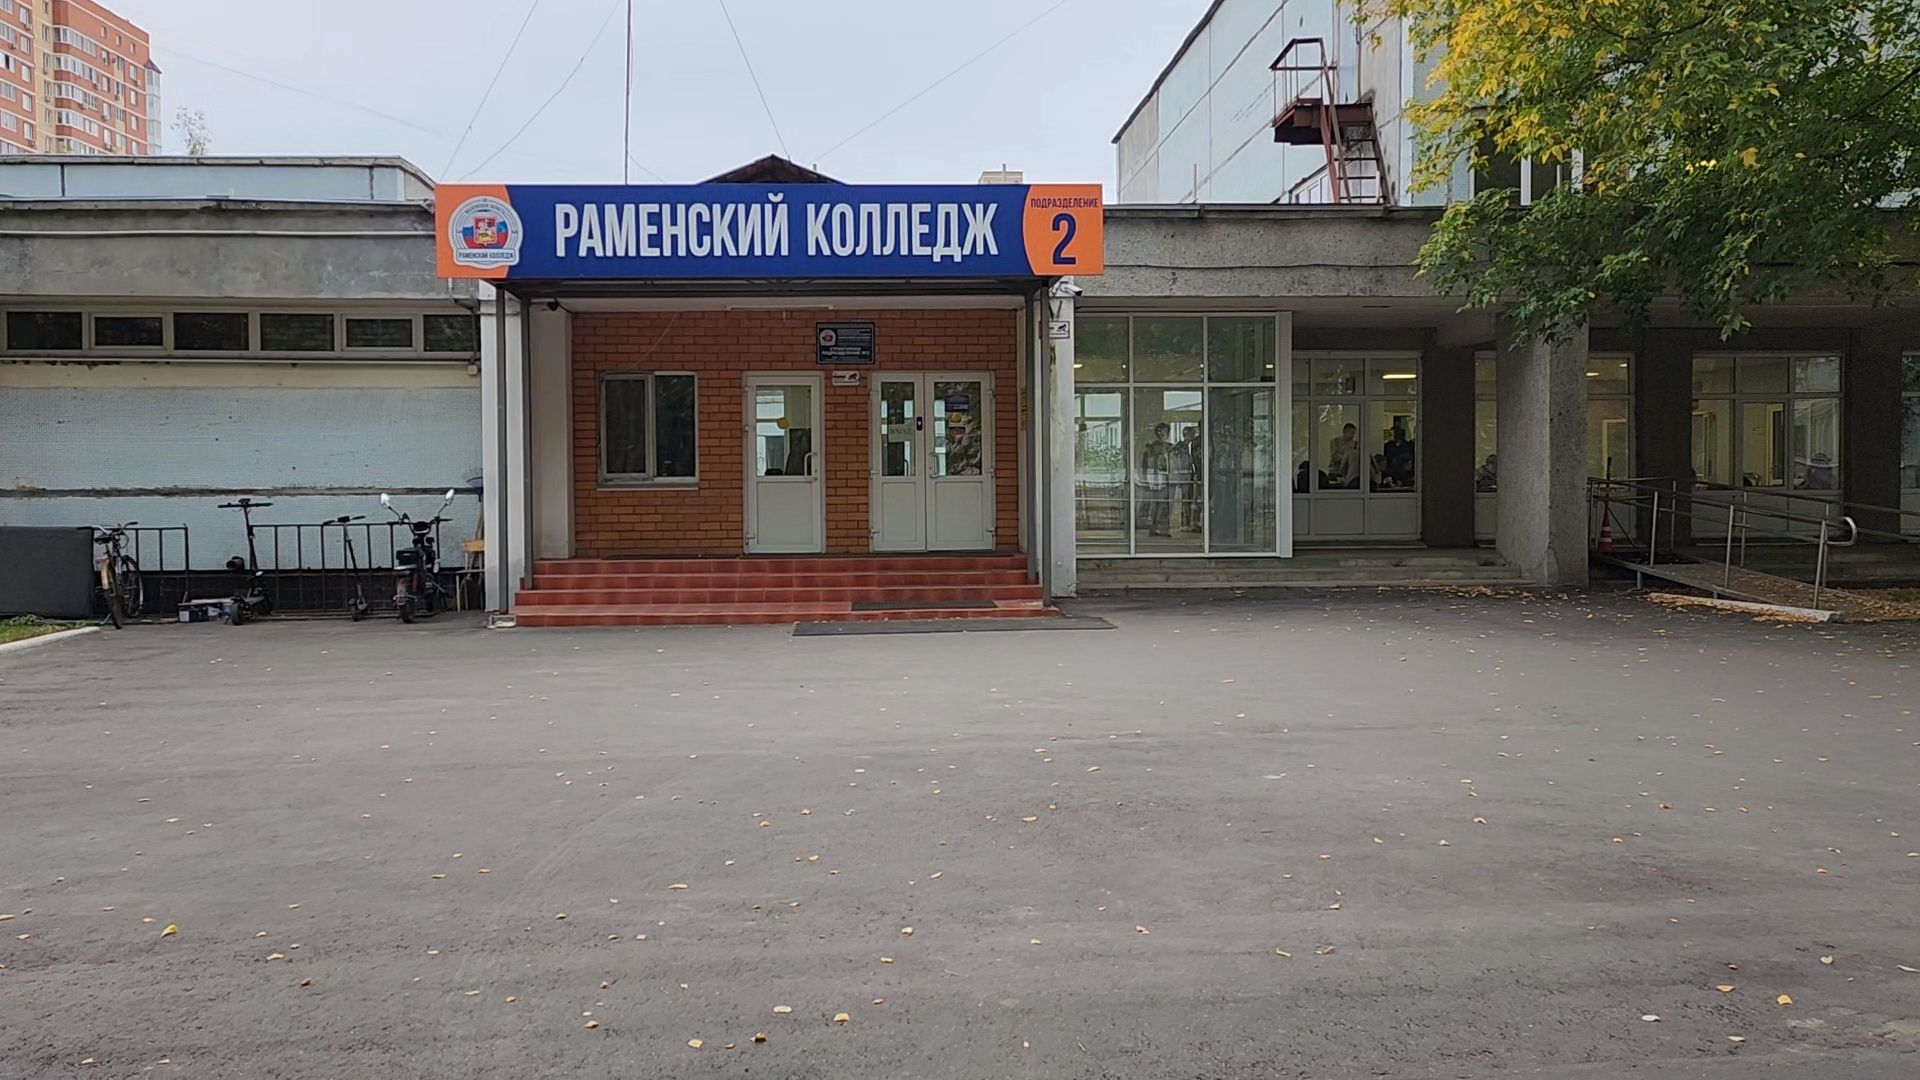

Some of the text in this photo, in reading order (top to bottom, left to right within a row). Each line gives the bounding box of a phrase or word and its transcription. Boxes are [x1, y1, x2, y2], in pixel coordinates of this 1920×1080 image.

[555, 192, 998, 262] РАМЕНСКИЙ КОЛЛЕДЖ
[1030, 198, 1098, 208] ПОДРАЗДЕЛЕНИЕ
[1052, 212, 1077, 264] 2
